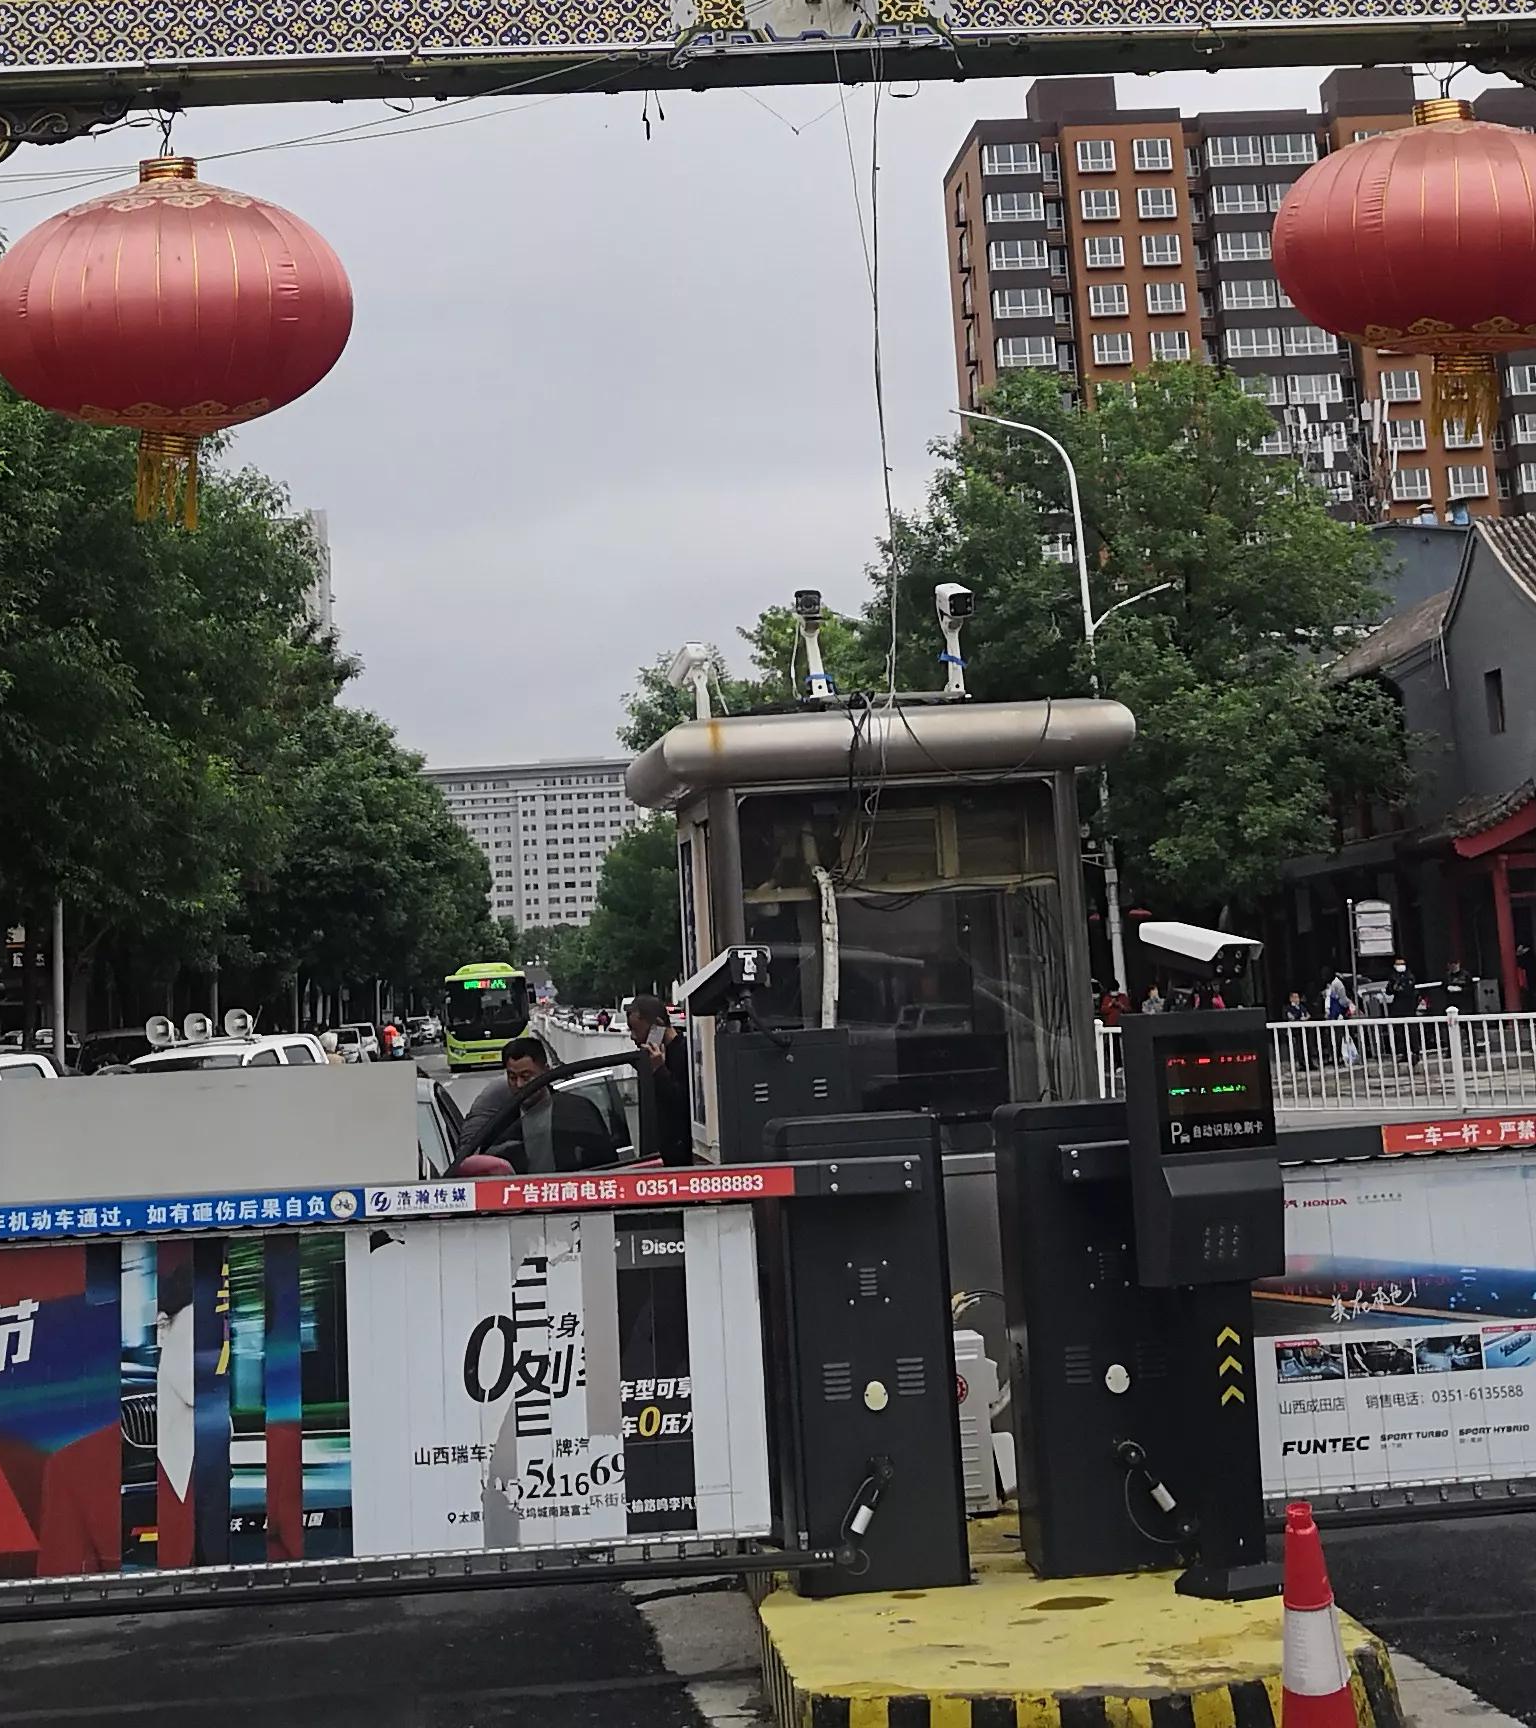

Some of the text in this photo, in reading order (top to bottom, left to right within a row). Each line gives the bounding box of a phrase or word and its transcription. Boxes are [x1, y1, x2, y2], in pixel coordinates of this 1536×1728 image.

[397, 1187, 466, 1206] 浩瀚传媒
[1303, 1199, 1348, 1208] HONDA
[1282, 1435, 1370, 1457] FUNTEC
